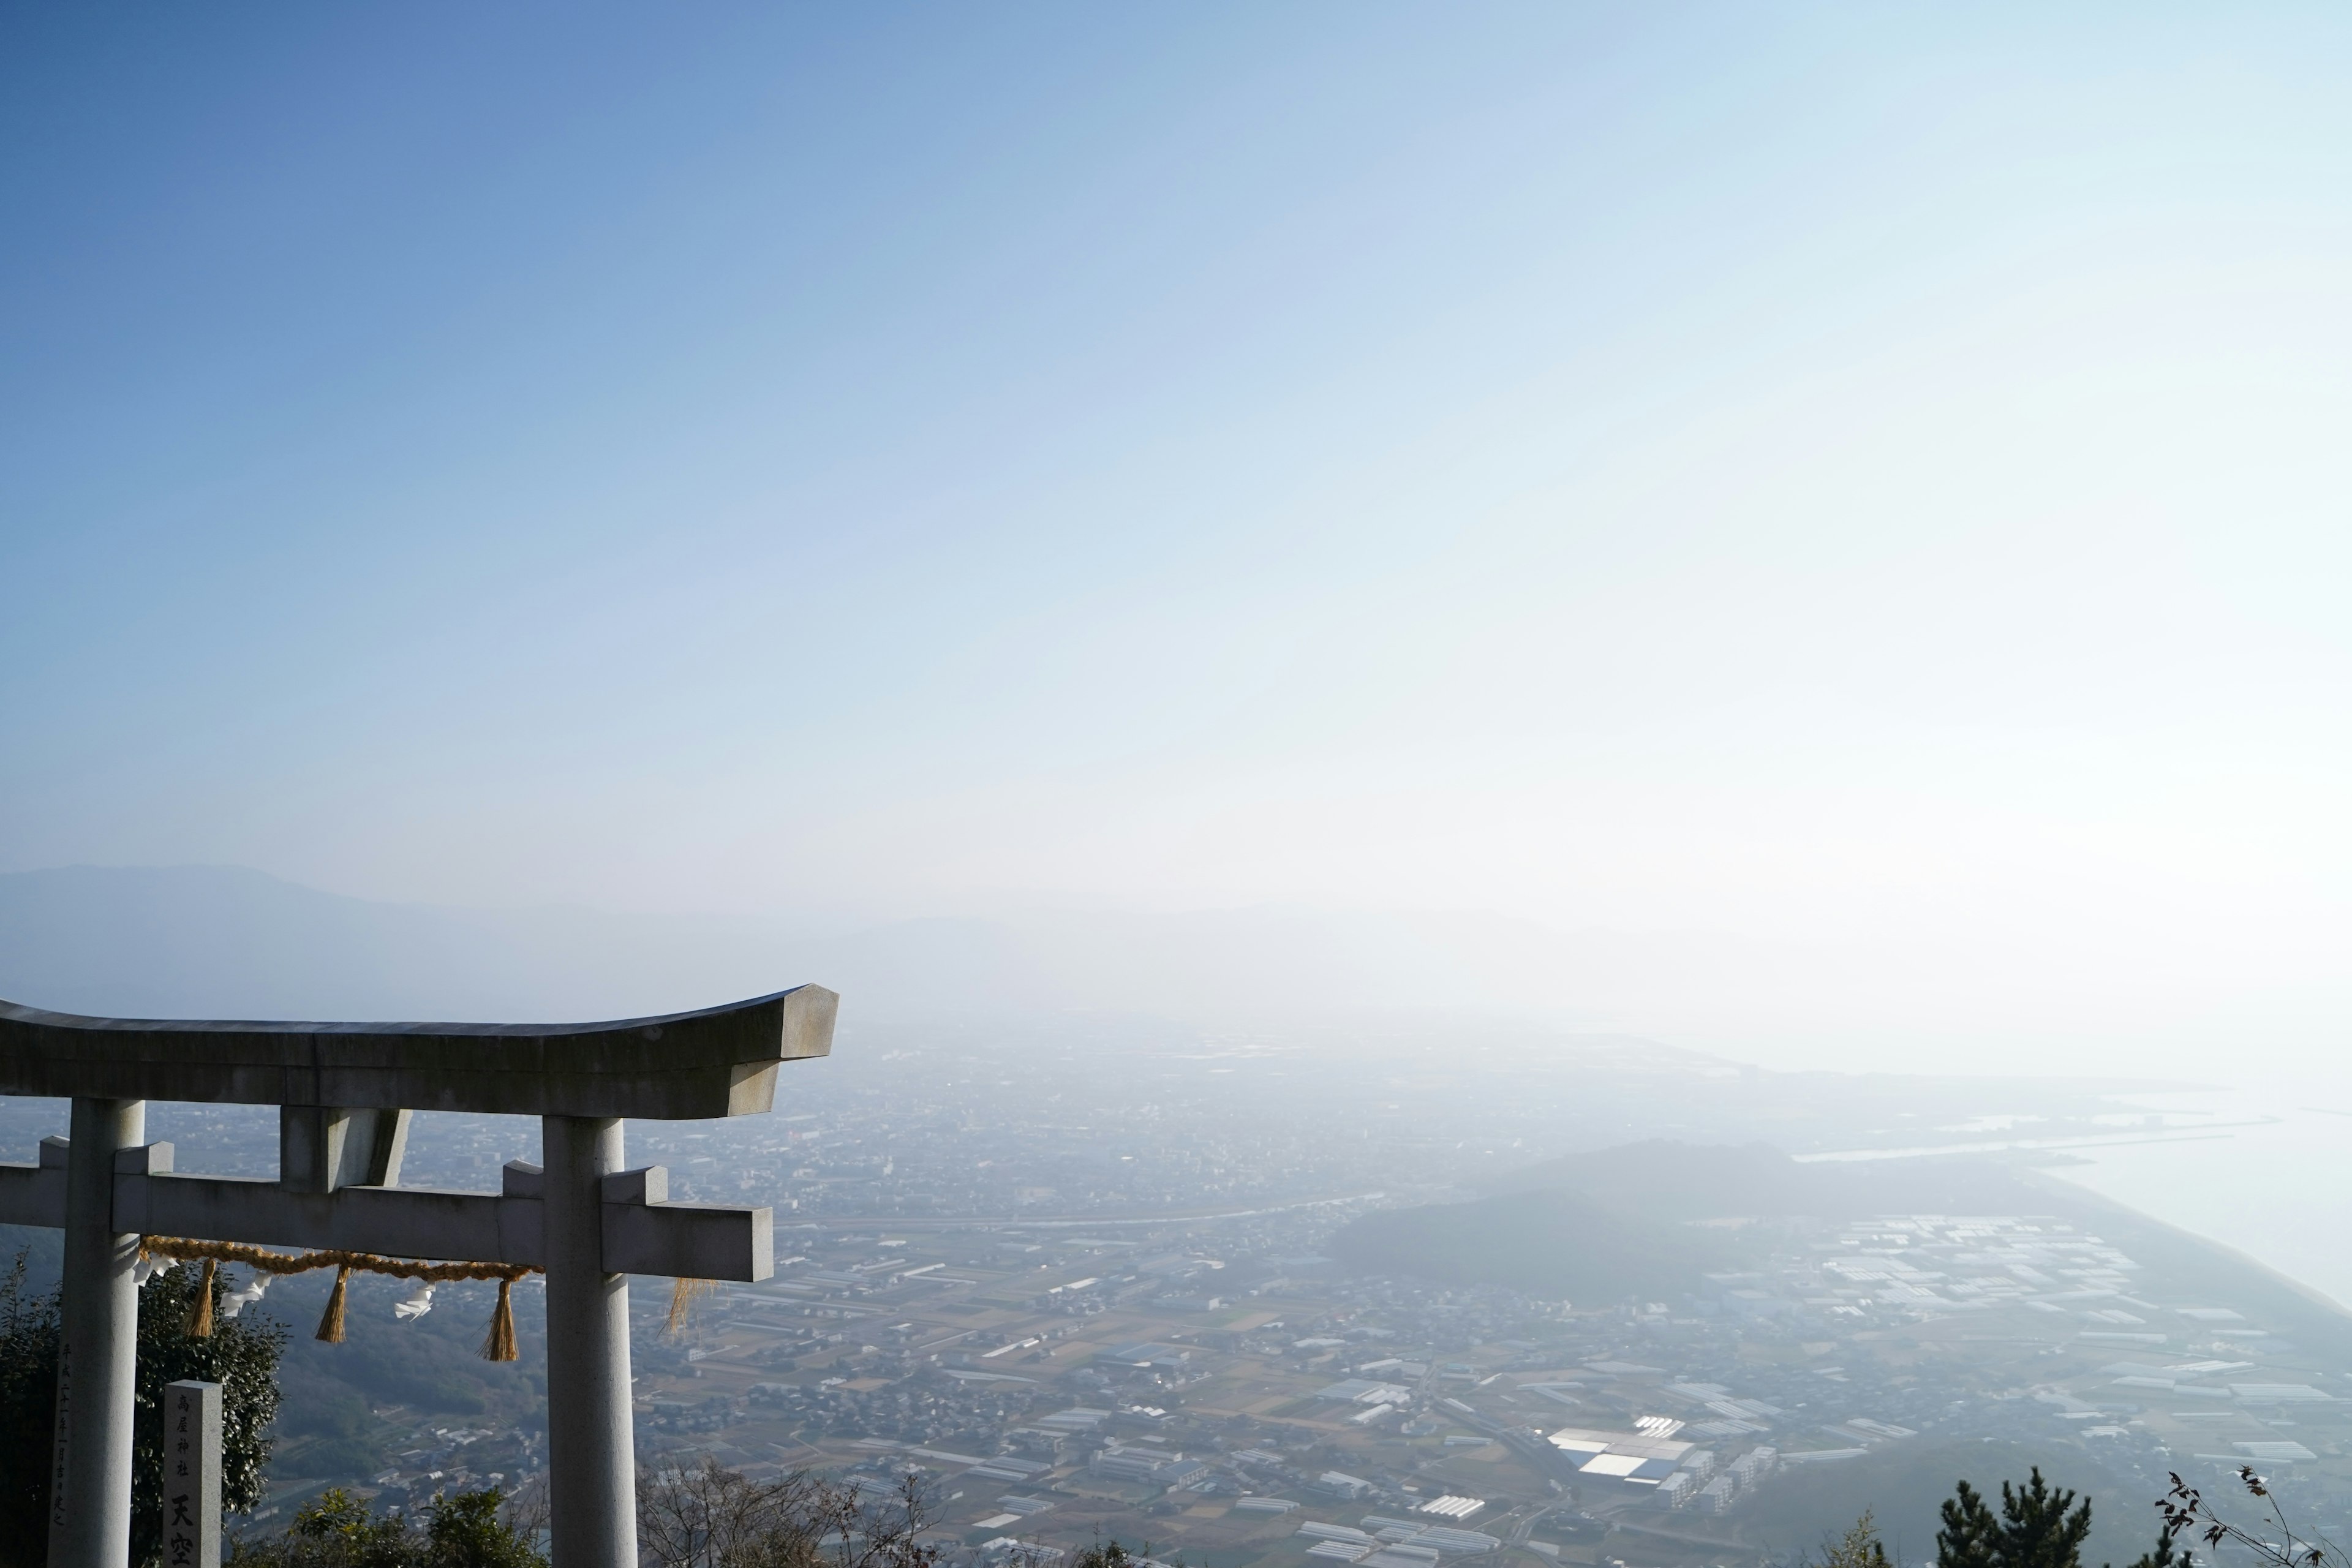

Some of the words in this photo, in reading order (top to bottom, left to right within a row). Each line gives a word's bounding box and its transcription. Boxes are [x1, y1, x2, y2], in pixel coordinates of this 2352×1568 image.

[176, 1394, 190, 1477] 高屋神社
[171, 1494, 194, 1566] 天空
